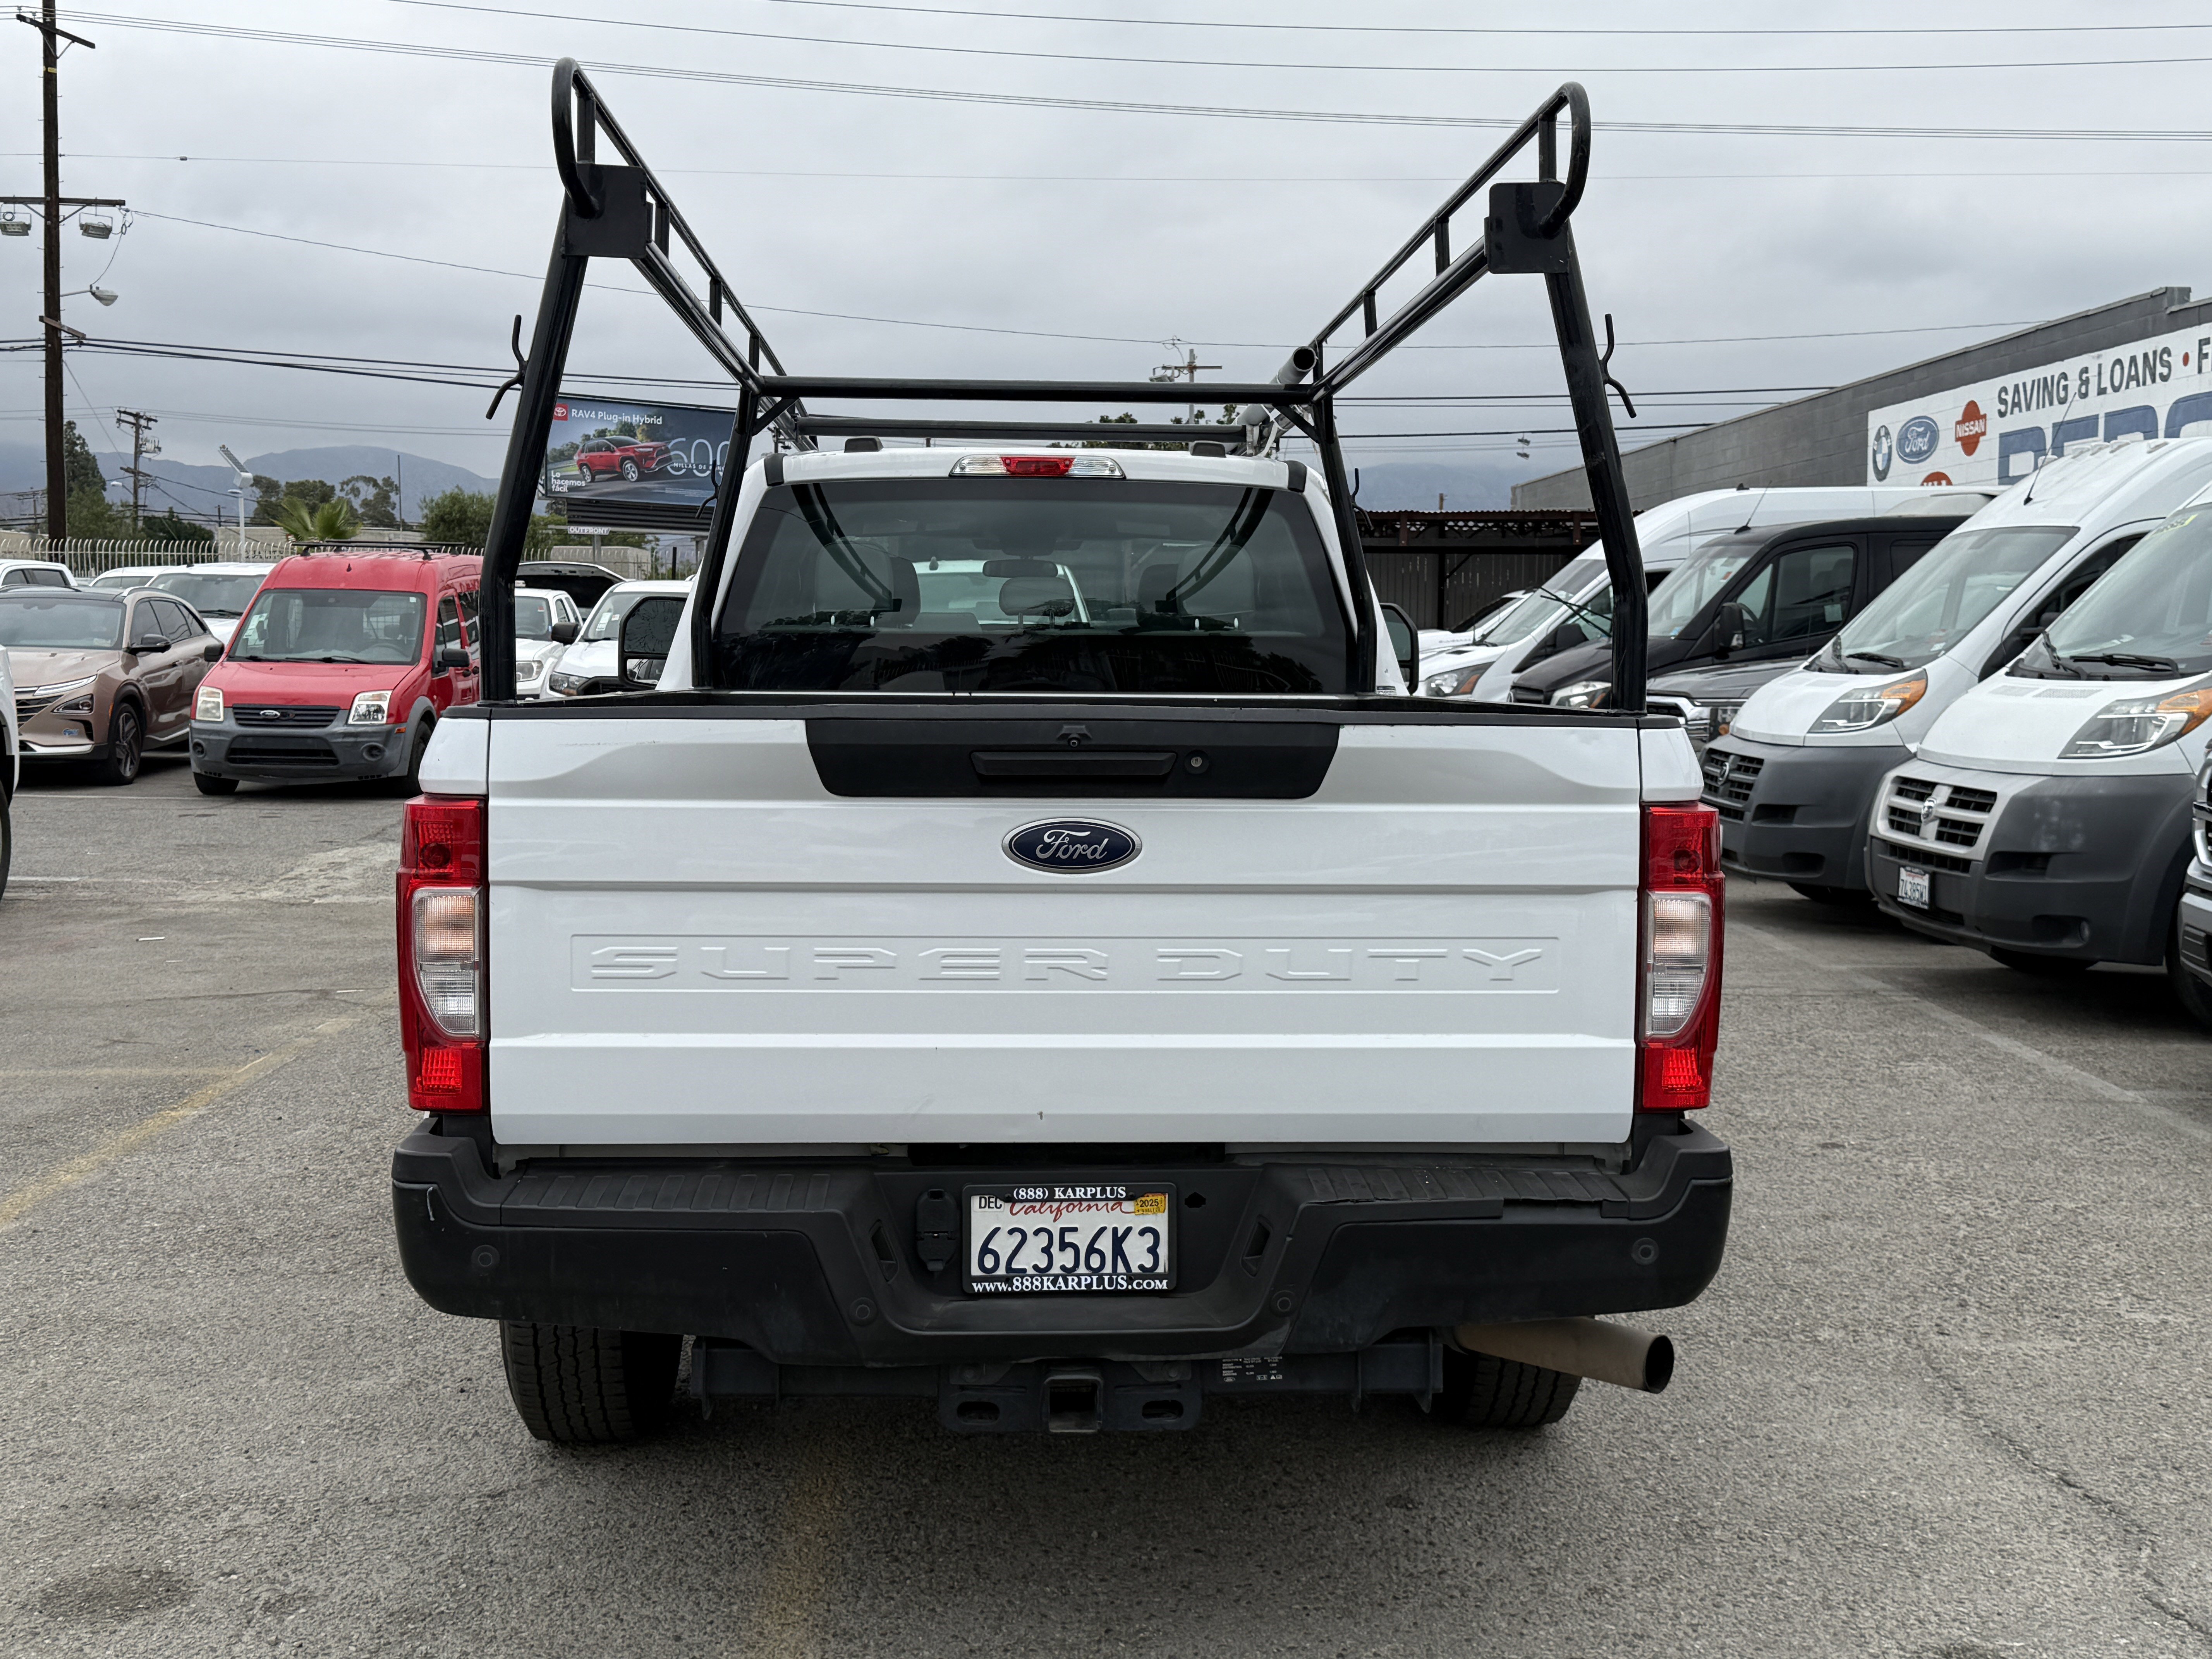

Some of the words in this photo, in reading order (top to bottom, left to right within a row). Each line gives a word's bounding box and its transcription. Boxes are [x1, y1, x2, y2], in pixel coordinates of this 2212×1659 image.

[1997, 371, 2069, 418] SAVING
[2077, 366, 2090, 399] &
[2096, 346, 2172, 396] LOANS
[571, 409, 596, 419] RAV4
[598, 411, 630, 423] Plug-in
[632, 414, 663, 425] Hybrid
[1956, 418, 1985, 438] NISSAN
[1905, 426, 1930, 453] Ford
[551, 477, 586, 487] hacemos
[1036, 829, 1109, 860] Ford
[592, 946, 1108, 981] SUPER
[1157, 948, 1543, 981] DUTY
[1013, 1187, 1049, 1200] (888)
[1053, 1186, 1127, 1199] KARPLUS
[978, 1196, 1003, 1209] DEC
[1009, 1201, 1135, 1223] California
[1139, 1199, 1159, 1208] 2025
[977, 1226, 1160, 1274] 62356K3
